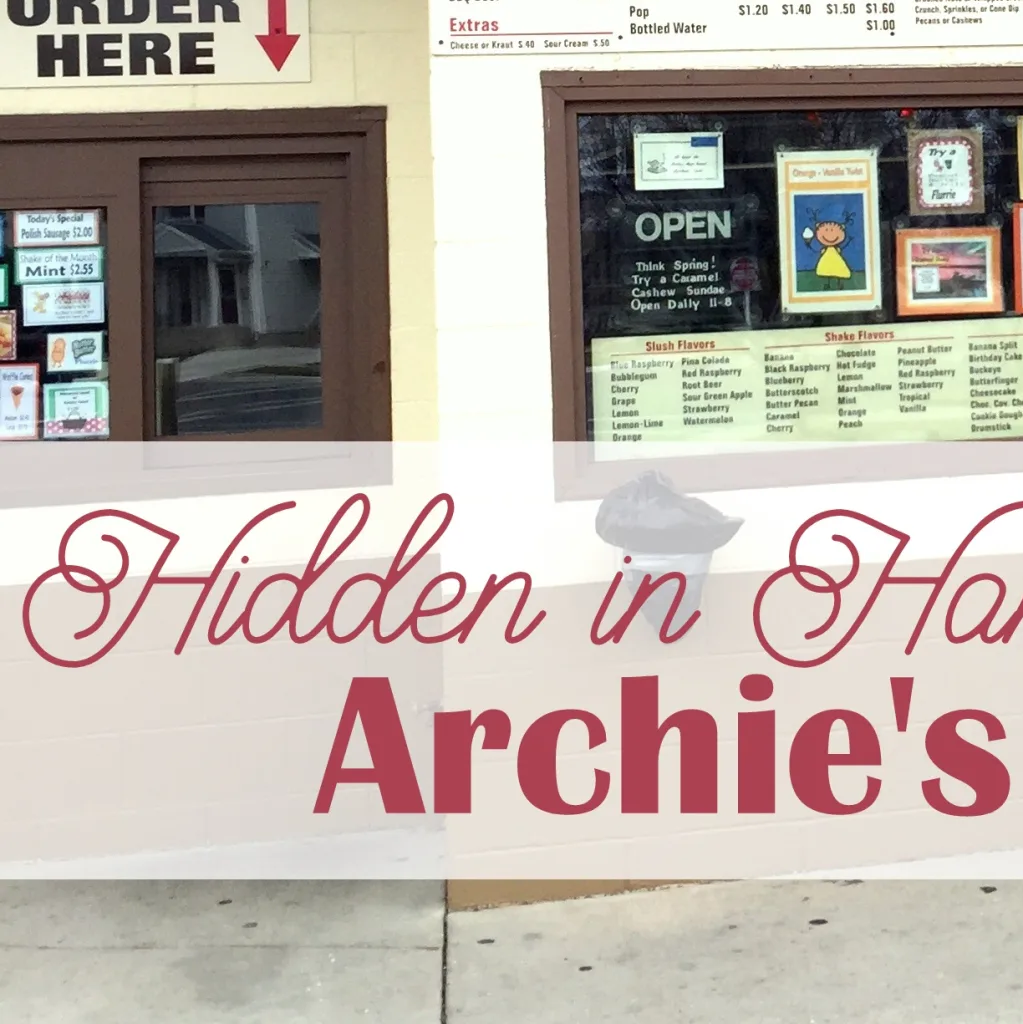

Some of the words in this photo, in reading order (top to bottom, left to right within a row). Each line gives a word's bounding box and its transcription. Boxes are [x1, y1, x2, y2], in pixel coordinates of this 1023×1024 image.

[630, 6, 649, 19] Pop
[630, 23, 669, 34] Bottled
[673, 23, 707, 33] Water
[867, 20, 895, 33] $1.00
[37, 32, 214, 78] HERE
[929, 148, 946, 157] Try
[27, 215, 55, 224] Today's
[57, 214, 83, 223] Special
[634, 210, 732, 242] OPEN
[21, 228, 41, 238] Polish
[44, 228, 70, 240] Sausage
[73, 227, 92, 237] $2.00
[674, 256, 716, 272] Spring!
[26, 266, 66, 276] Mint
[71, 264, 93, 275] $2.55
[632, 275, 651, 286] Try
[660, 276, 666, 284] a
[632, 287, 676, 298] Cashew
[687, 285, 725, 296] Sundae
[631, 300, 660, 312] Open
[825, 332, 855, 342] Shake
[858, 331, 894, 341] Flavors
[646, 341, 674, 351] Slush
[678, 340, 715, 350] Flavors
[969, 354, 1002, 362] Birthday
[611, 373, 657, 382] Bubblegum
[970, 377, 1018, 386] Butterfinger
[611, 385, 639, 394] Cherry
[899, 393, 930, 402] Tropical
[683, 404, 729, 413] Strawberry
[766, 401, 791, 409] Butter
[794, 399, 818, 407] Pecan
[899, 404, 926, 413] Vanilla
[612, 409, 639, 418] Lemon
[683, 416, 733, 425] Watermelon
